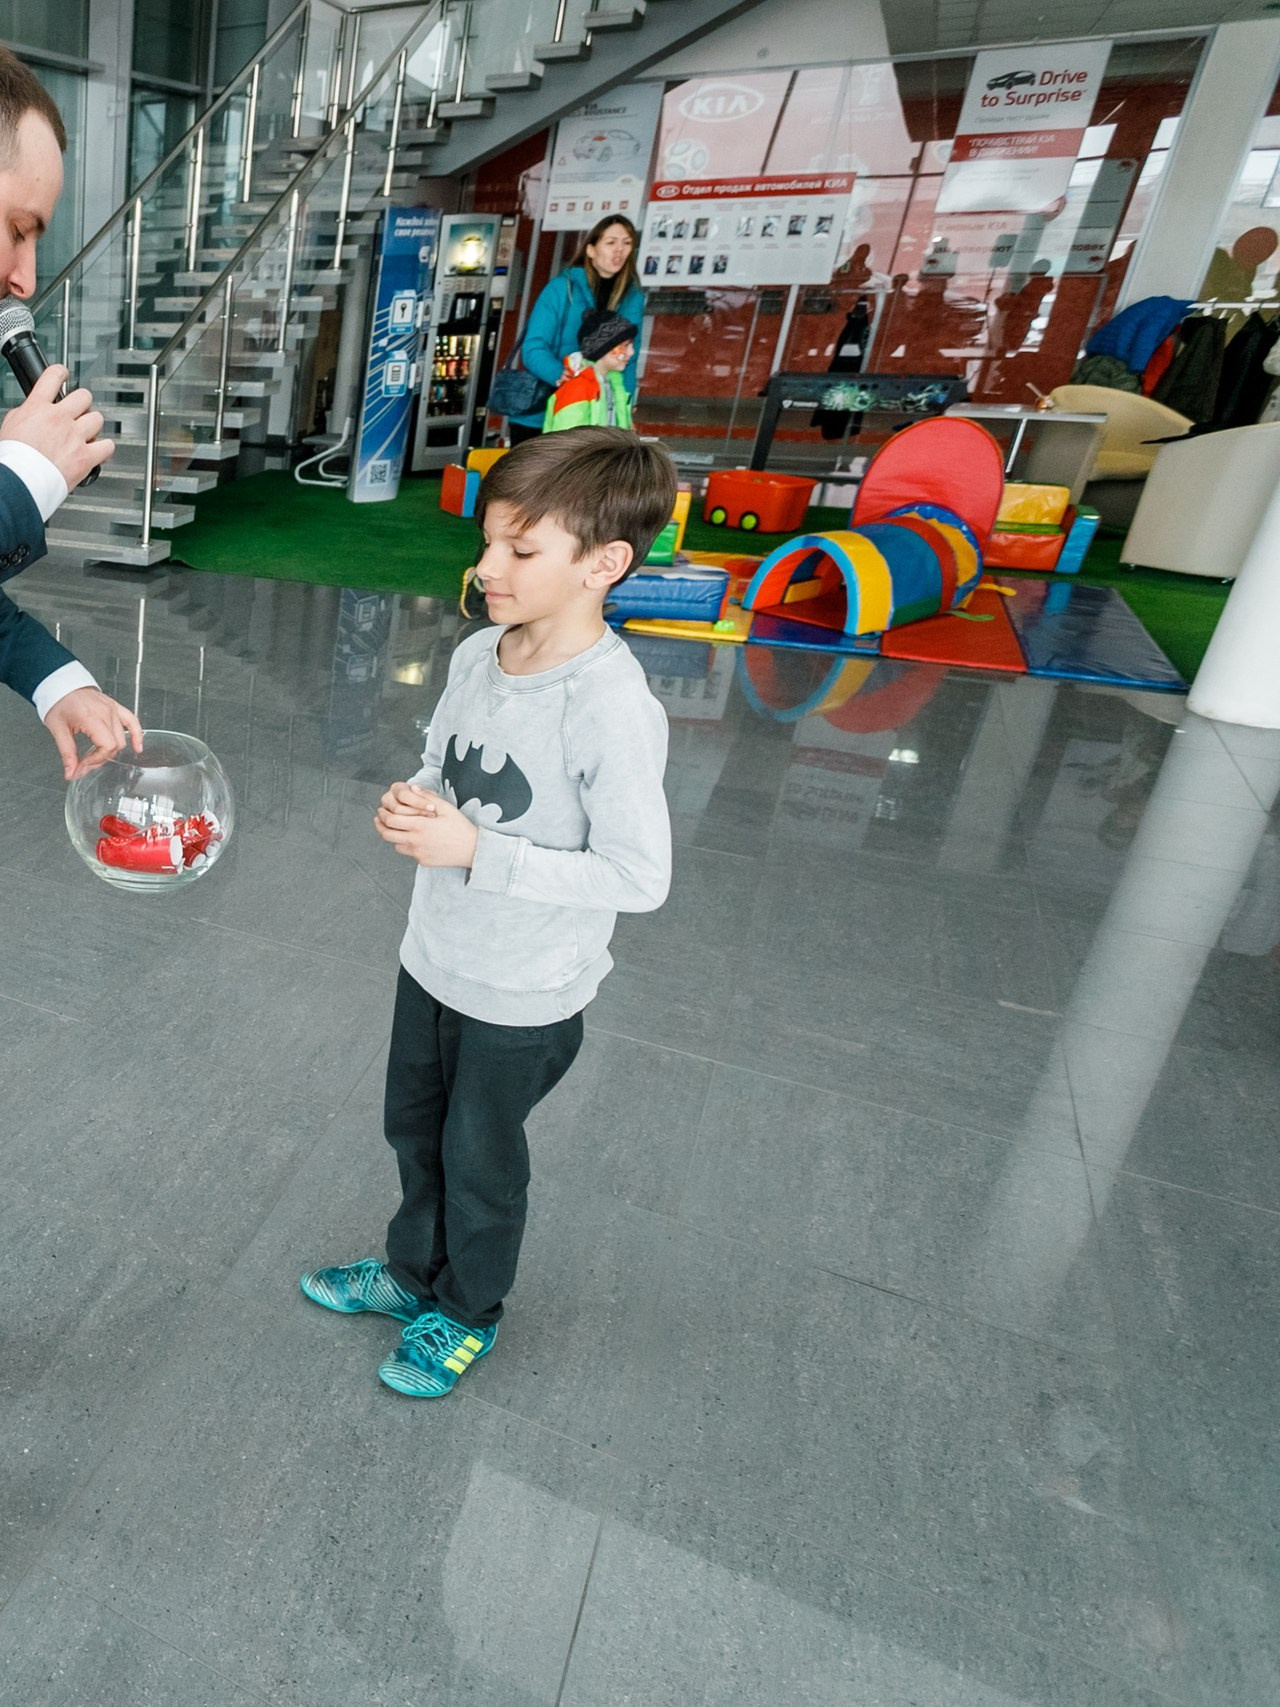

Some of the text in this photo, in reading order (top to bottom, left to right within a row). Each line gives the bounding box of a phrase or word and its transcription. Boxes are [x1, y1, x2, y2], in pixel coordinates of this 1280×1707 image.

[1038, 69, 1088, 86] Drive
[693, 95, 749, 116] KIA
[981, 93, 999, 108] to
[682, 184, 712, 196] Отдел
[713, 184, 752, 195] продаж
[754, 180, 821, 192] автомобилей
